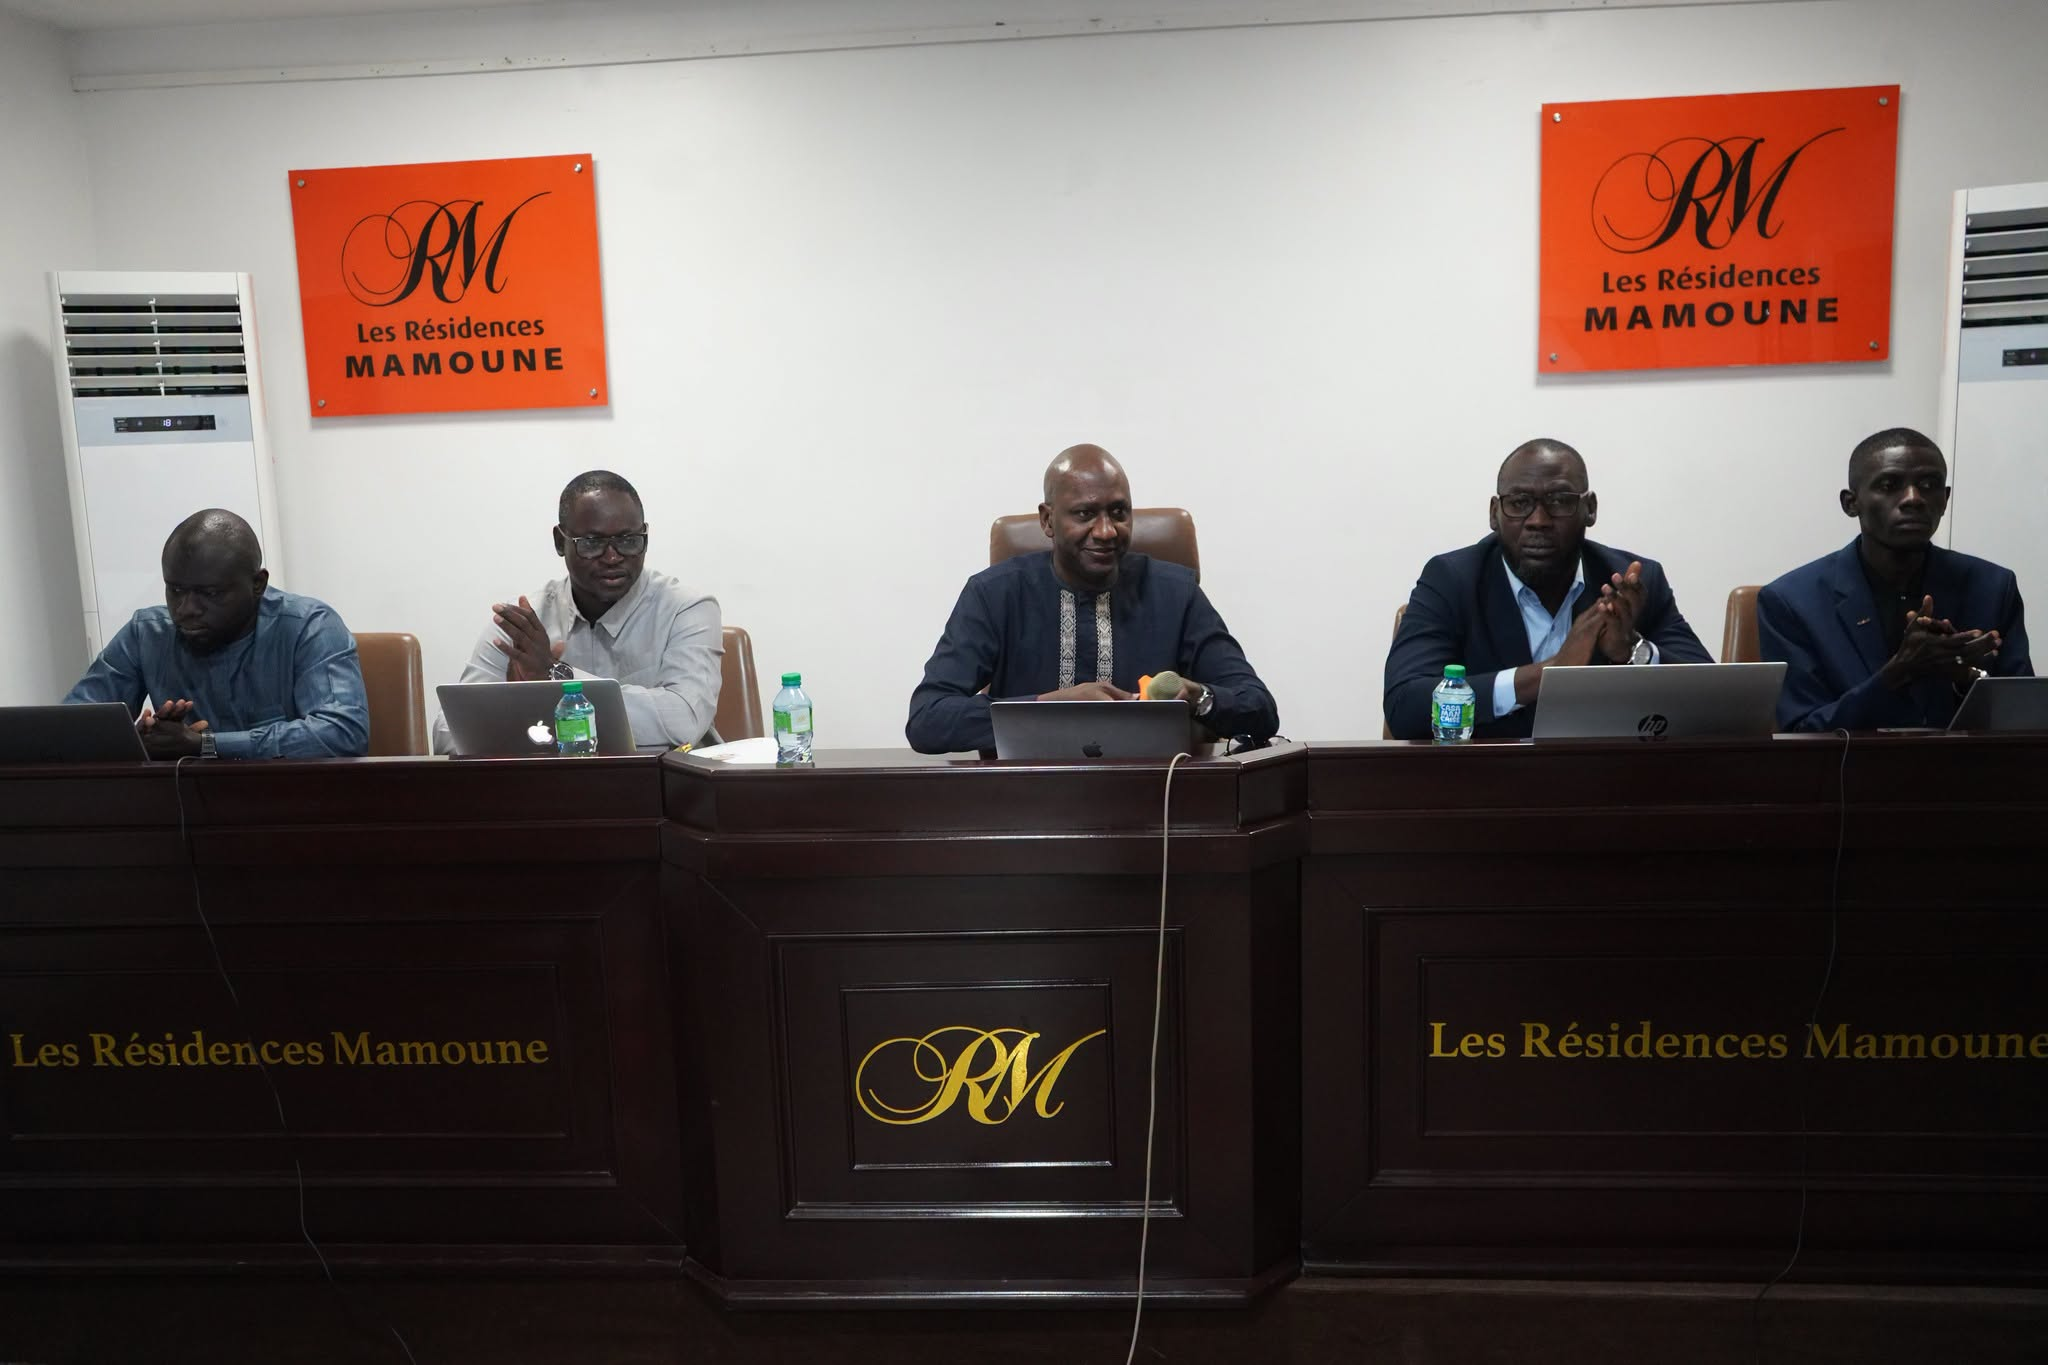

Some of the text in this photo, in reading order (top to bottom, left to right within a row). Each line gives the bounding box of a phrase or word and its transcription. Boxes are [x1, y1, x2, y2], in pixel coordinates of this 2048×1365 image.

[1592, 127, 1846, 254] RM
[341, 191, 552, 307] RM
[1602, 263, 1821, 294] Les Résidences
[357, 316, 545, 344] Les Résidences
[1583, 297, 1839, 332] MAMOUNE
[345, 347, 563, 379] MAMOUNE
[10, 1030, 549, 1067] Les Résidences Mamoune
[1429, 1020, 2048, 1059] Les Résidences Mamoune
[855, 1025, 1107, 1125] RM
